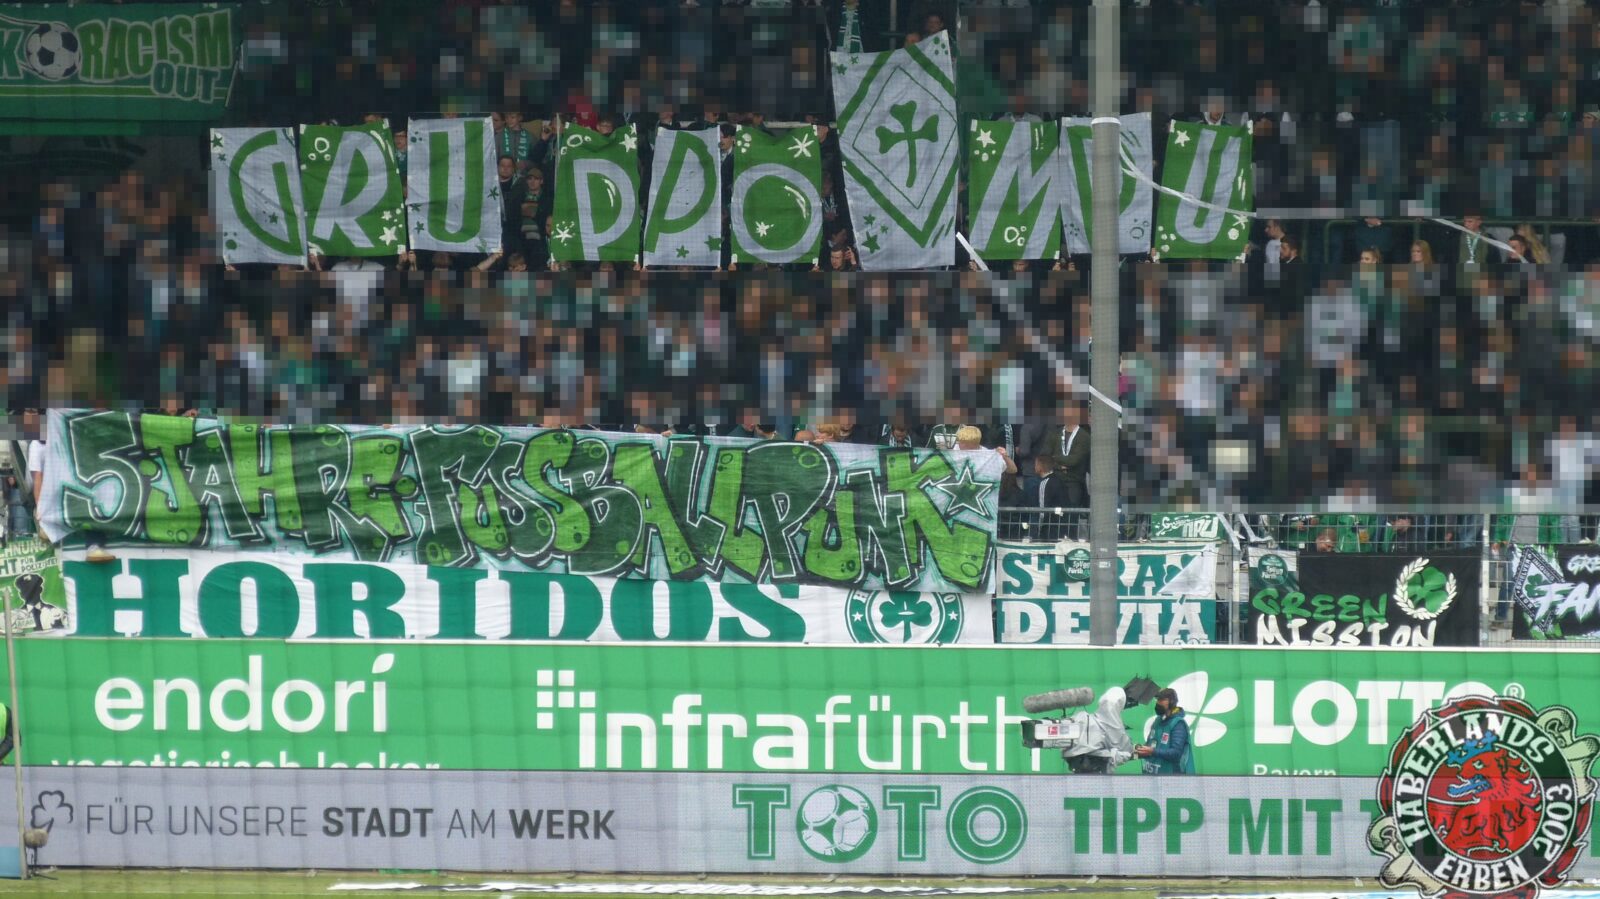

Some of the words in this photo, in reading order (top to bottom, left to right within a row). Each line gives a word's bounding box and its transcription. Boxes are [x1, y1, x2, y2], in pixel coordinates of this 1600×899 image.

[77, 9, 232, 83] RACISM
[152, 60, 220, 104] OUT
[62, 410, 145, 538] 5
[63, 558, 806, 642] HORIDOS
[1252, 587, 1388, 625] GREEN
[1256, 613, 1436, 646] MISSION
[94, 653, 395, 733] endori
[578, 693, 1041, 772] infrafürth
[86, 798, 154, 835] FÜR
[168, 804, 307, 837] UNSERE
[322, 807, 434, 839] STADT
[447, 808, 496, 839] AM
[509, 809, 616, 840] WERK
[1064, 797, 1204, 855] TIPP
[1229, 798, 1342, 856] MIT
